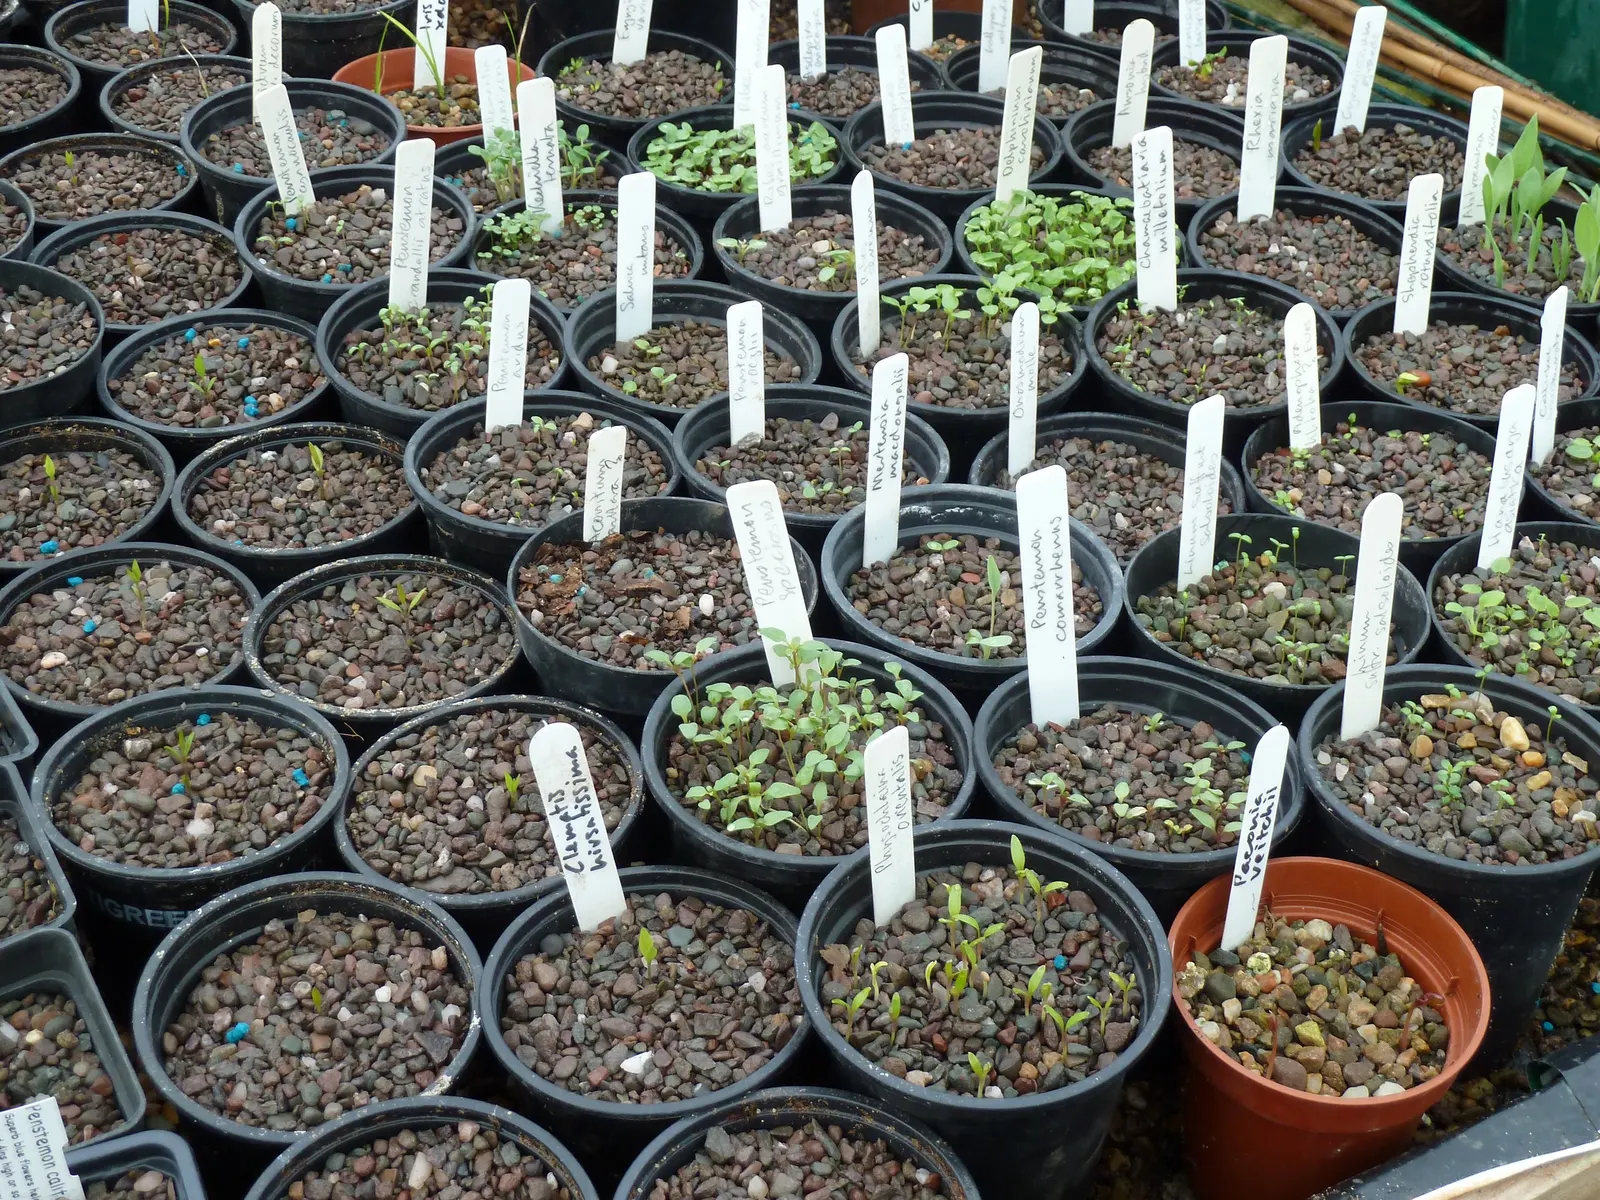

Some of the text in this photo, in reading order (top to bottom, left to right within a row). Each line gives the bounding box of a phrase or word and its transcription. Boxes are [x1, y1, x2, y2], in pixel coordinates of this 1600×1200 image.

[419, 2, 434, 31] Iris
[1002, 85, 1023, 178] Delphinium
[1246, 92, 1263, 153] Rhexia
[393, 184, 413, 269] Penstemon
[1150, 149, 1168, 253] millefolium
[619, 262, 635, 314] Salvia
[491, 313, 513, 393] Penstemon
[734, 317, 749, 403] Penstemon
[1012, 311, 1027, 419] Onosmodium
[1027, 349, 1038, 393] molle
[871, 397, 890, 493] Mertensia
[746, 501, 776, 608] Penstemon
[1030, 526, 1047, 632] Penstemon
[1183, 510, 1199, 577] Linum
[551, 788, 585, 874] Clematis
[887, 751, 910, 832] orientalis
[1232, 790, 1264, 888] Paeonia
[4, 1112, 20, 1140] Superb
[14, 1141, 25, 1158] blue
[20, 1158, 35, 1188] flowers
[26, 1104, 57, 1171] Penstemon
